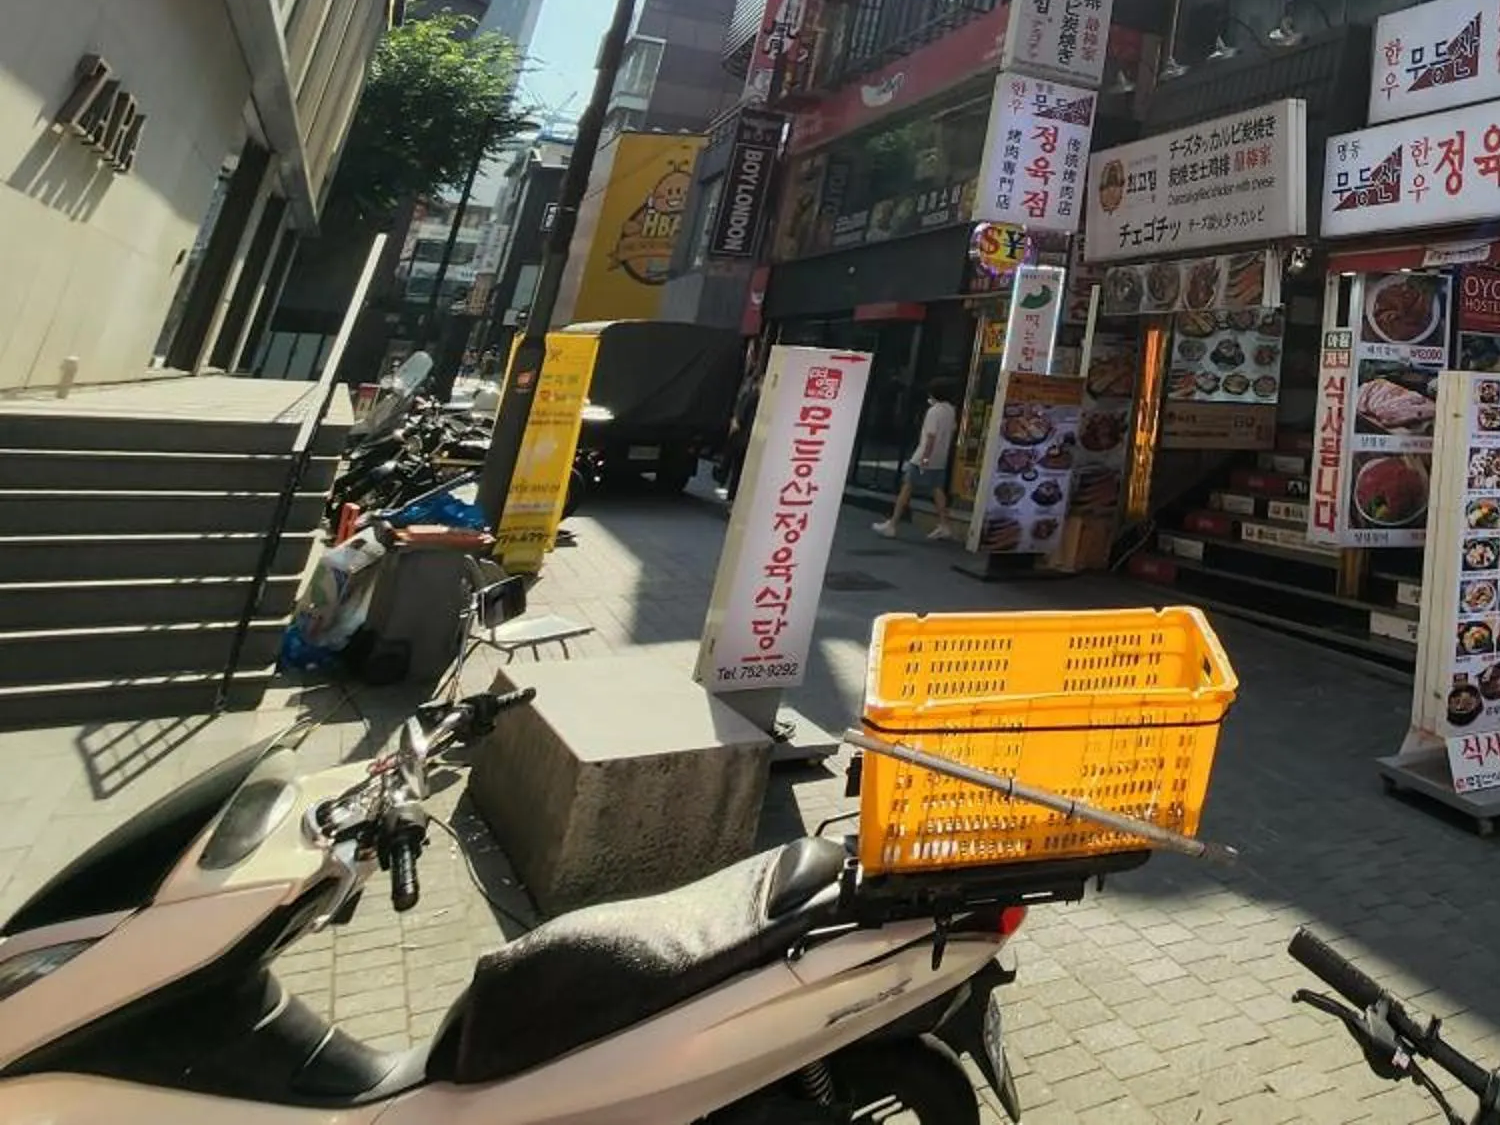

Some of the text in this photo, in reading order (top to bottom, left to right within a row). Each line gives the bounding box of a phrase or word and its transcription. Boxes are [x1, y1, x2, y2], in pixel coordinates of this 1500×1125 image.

[1380, 37, 1401, 101] 한우
[1020, 125, 1060, 219] 정육점
[723, 183, 759, 252] LONDON
[1120, 215, 1182, 248] チェゴチッ
[1314, 377, 1346, 533] 식사됩니다
